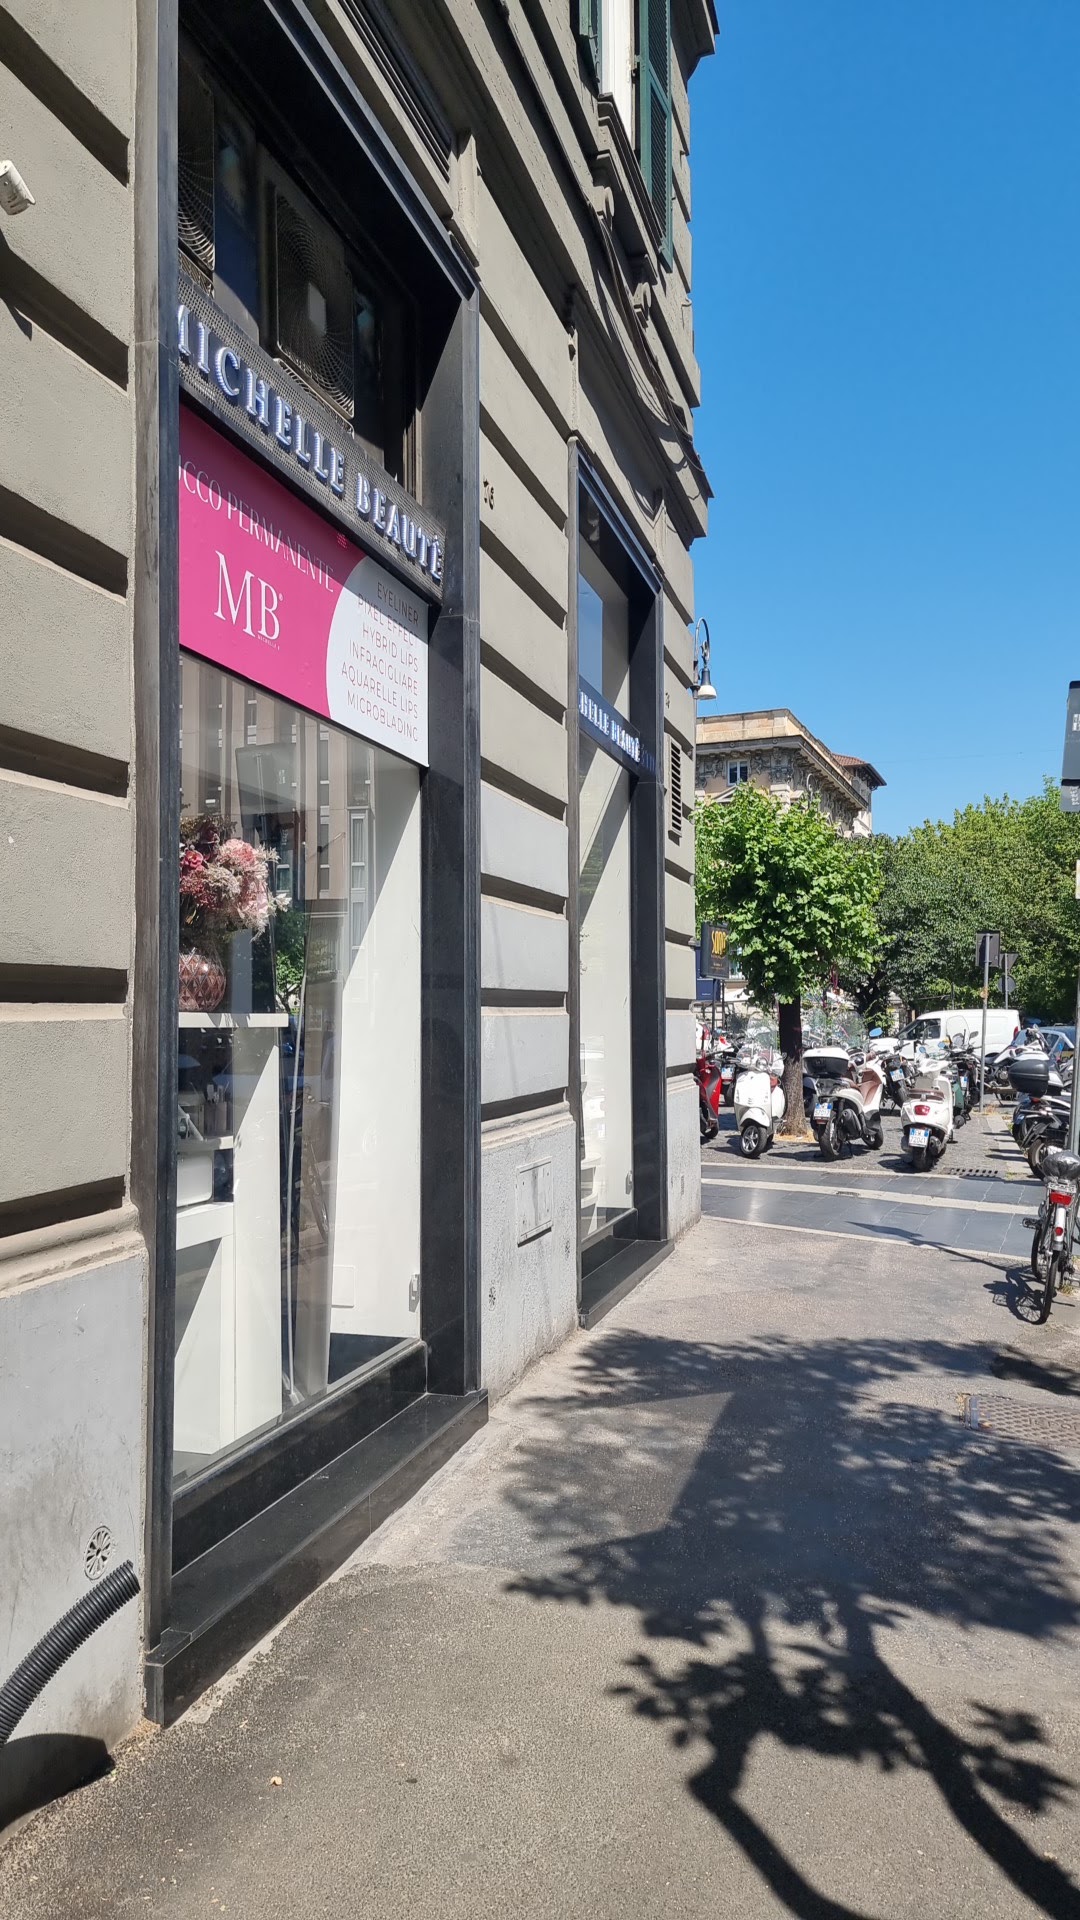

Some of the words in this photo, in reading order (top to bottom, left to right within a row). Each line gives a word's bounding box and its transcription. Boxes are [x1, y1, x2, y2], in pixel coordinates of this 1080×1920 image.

[179, 454, 222, 511] CCO
[227, 491, 334, 593] PERMANENTE
[356, 471, 442, 580] BEAUTÉ
[358, 592, 385, 626] PIXEL
[377, 581, 419, 626] EYELINER
[349, 639, 419, 697] INFRACIGLIARE
[363, 621, 398, 658] HYBRID
[400, 648, 419, 673] LIPS
[341, 660, 398, 708] AQUARELLE
[400, 694, 419, 719] LIPS
